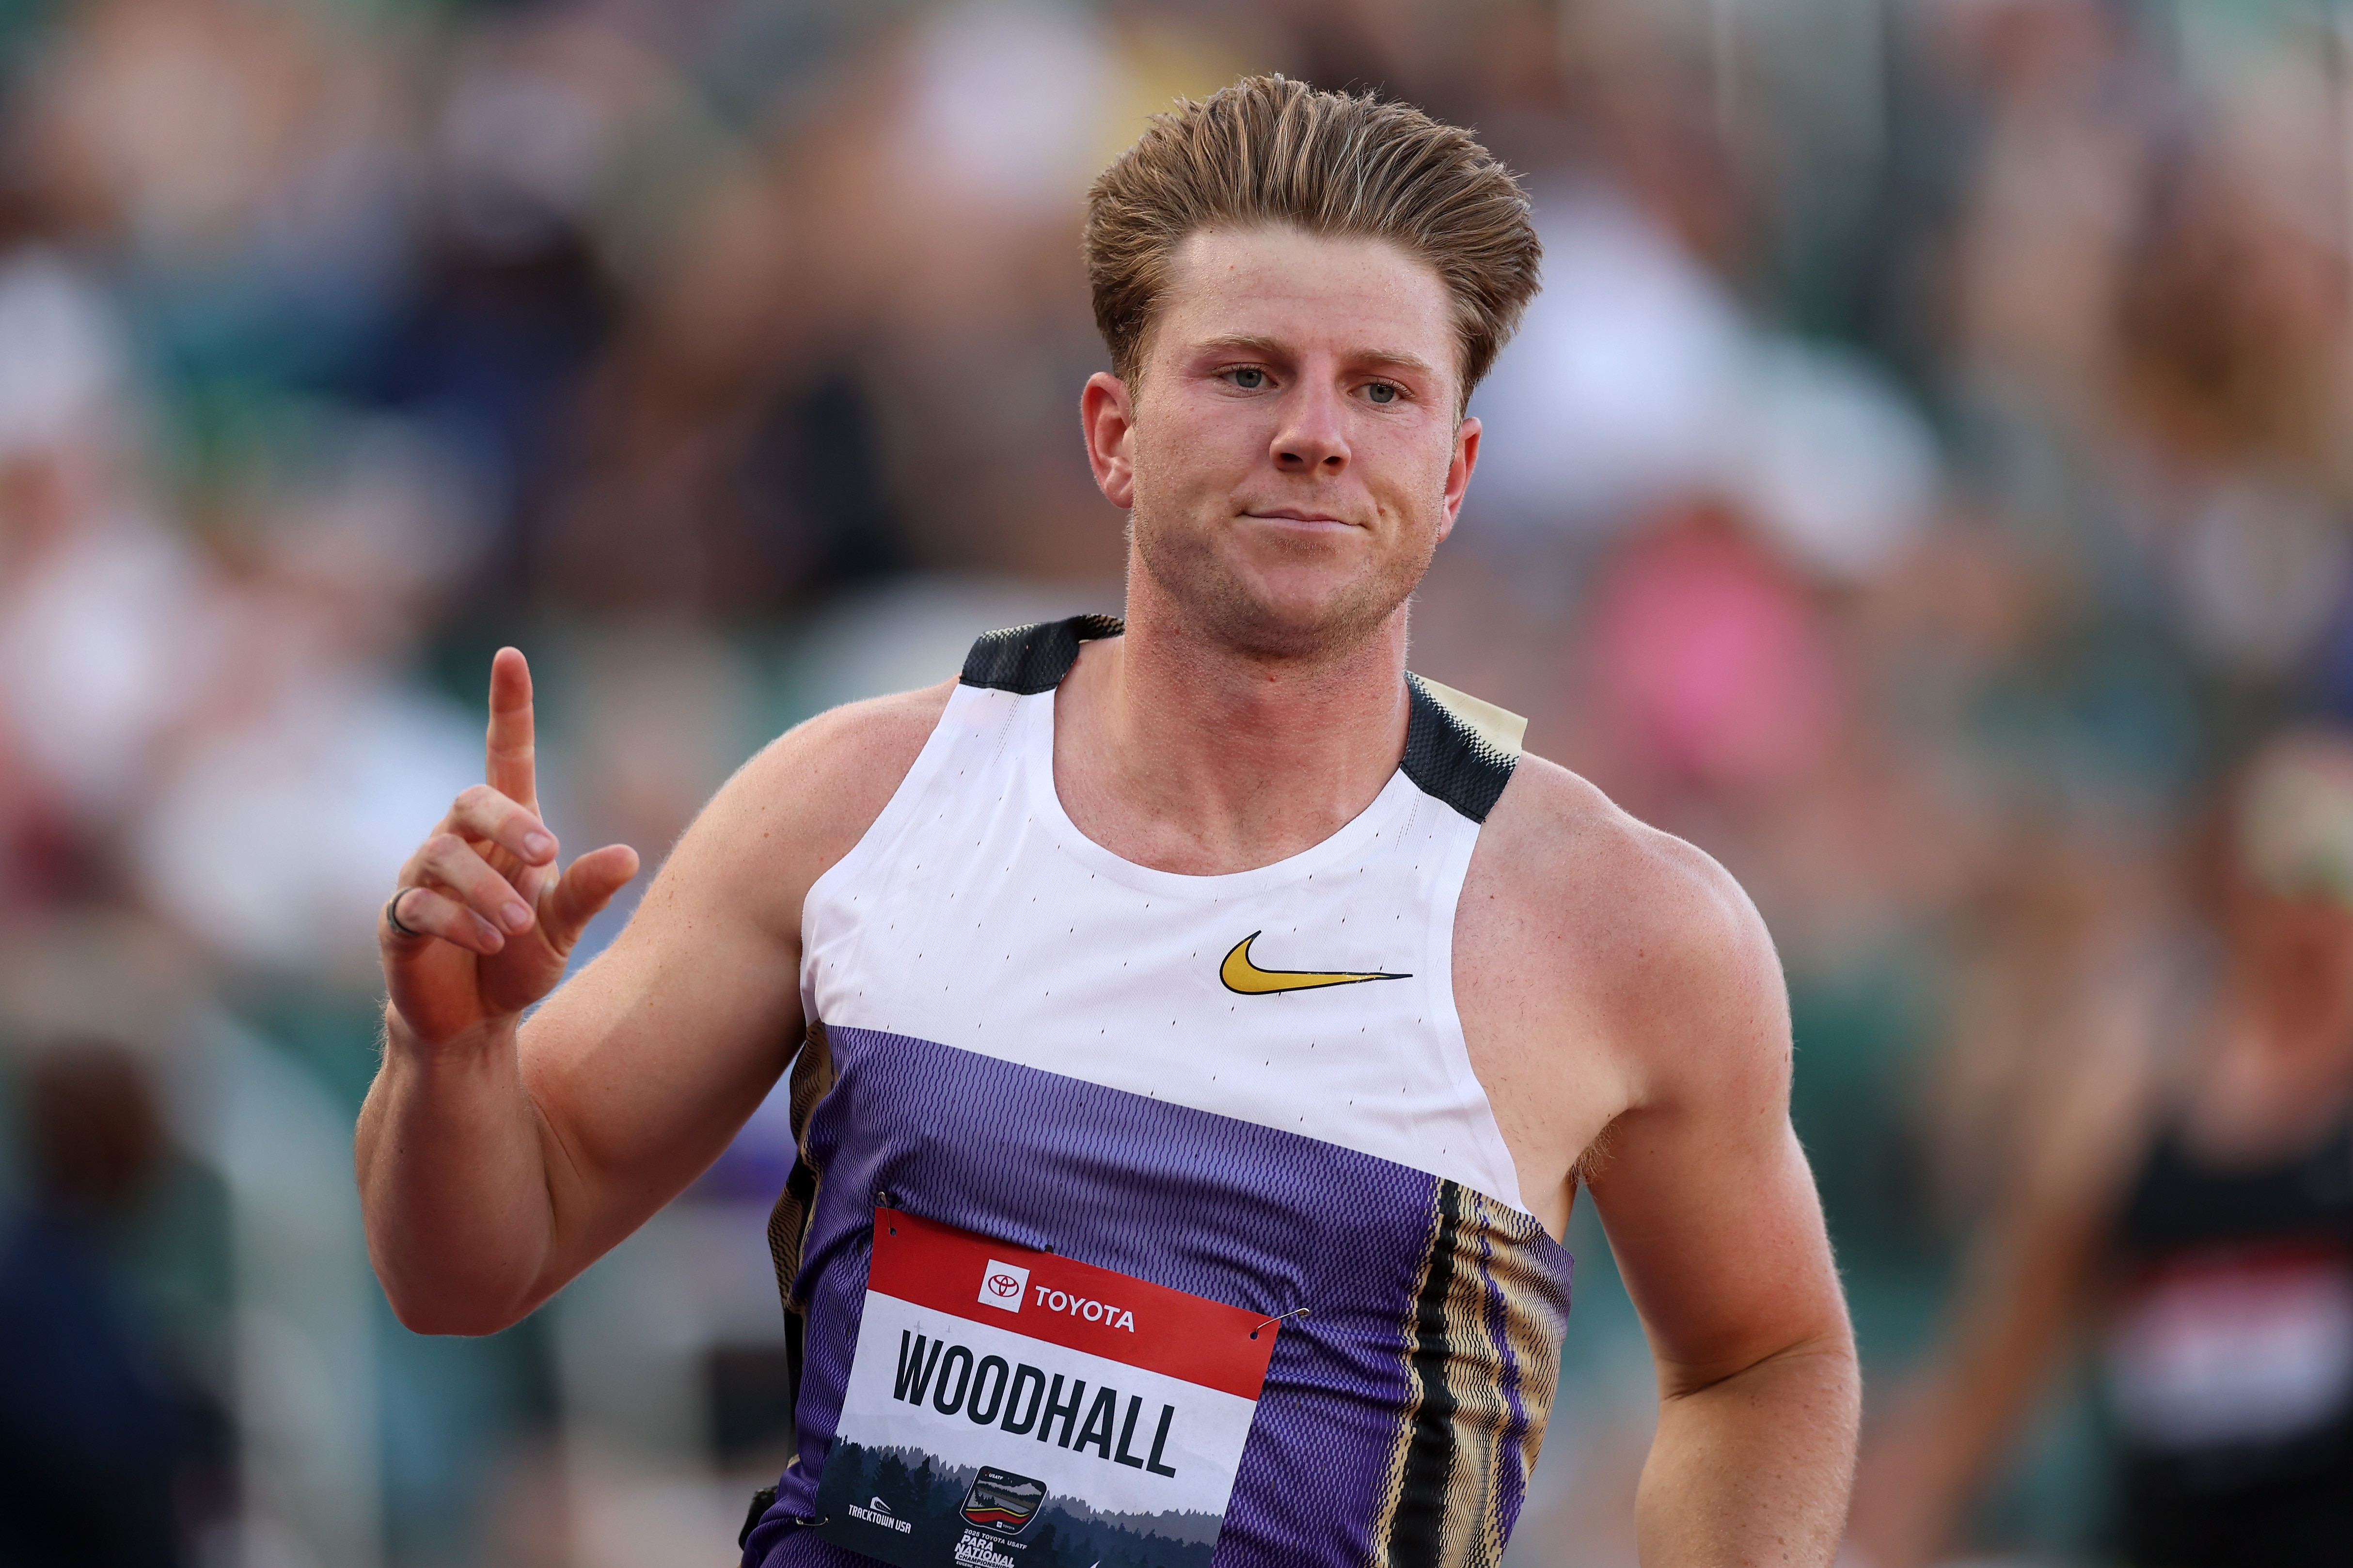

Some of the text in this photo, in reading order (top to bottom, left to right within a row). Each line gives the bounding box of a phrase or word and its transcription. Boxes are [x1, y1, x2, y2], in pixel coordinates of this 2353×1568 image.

[1035, 1286, 1135, 1333] TOYOTA
[893, 1329, 1176, 1478] WOODHALL
[849, 1504, 912, 1534] TRACKTOWN USA
[961, 1534, 994, 1551] PARA
[964, 1528, 1027, 1550] 2025 TOYOTA USATF
[954, 1543, 1014, 1568] NATIONAL
